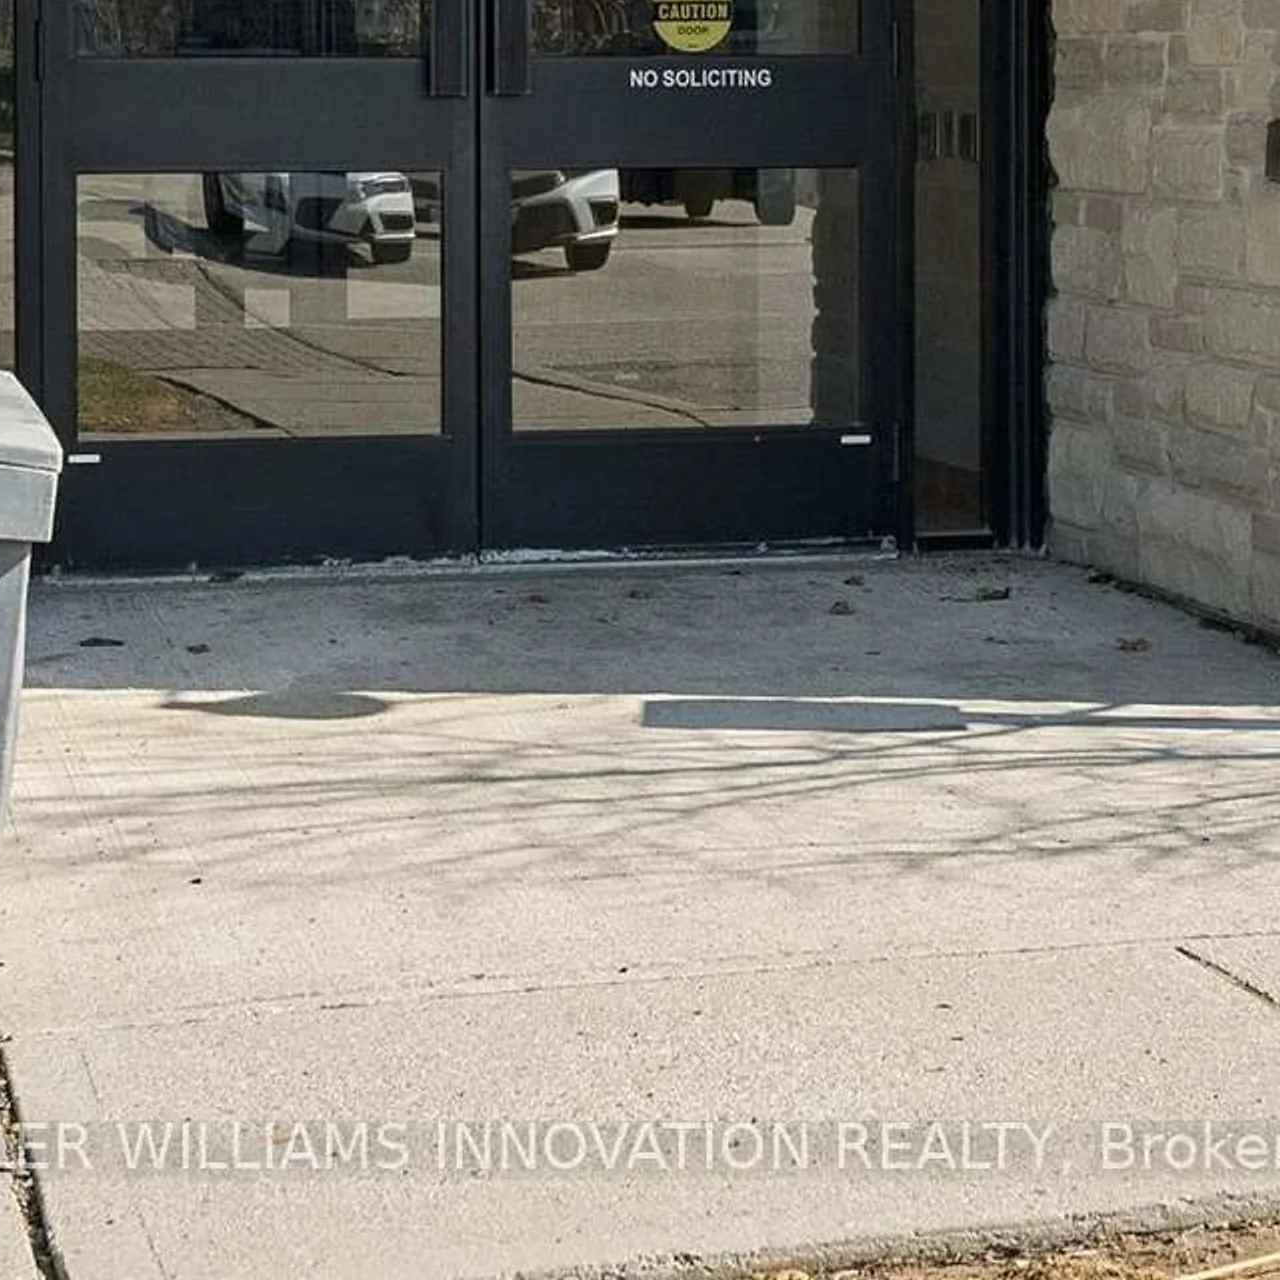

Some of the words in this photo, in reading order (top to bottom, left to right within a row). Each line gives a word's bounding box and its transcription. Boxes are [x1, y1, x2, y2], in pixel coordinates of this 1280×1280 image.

[658, 3, 728, 19] CAUTION
[677, 26, 709, 35] DOOR
[629, 70, 658, 88] NO
[662, 70, 772, 88] SOLICITING
